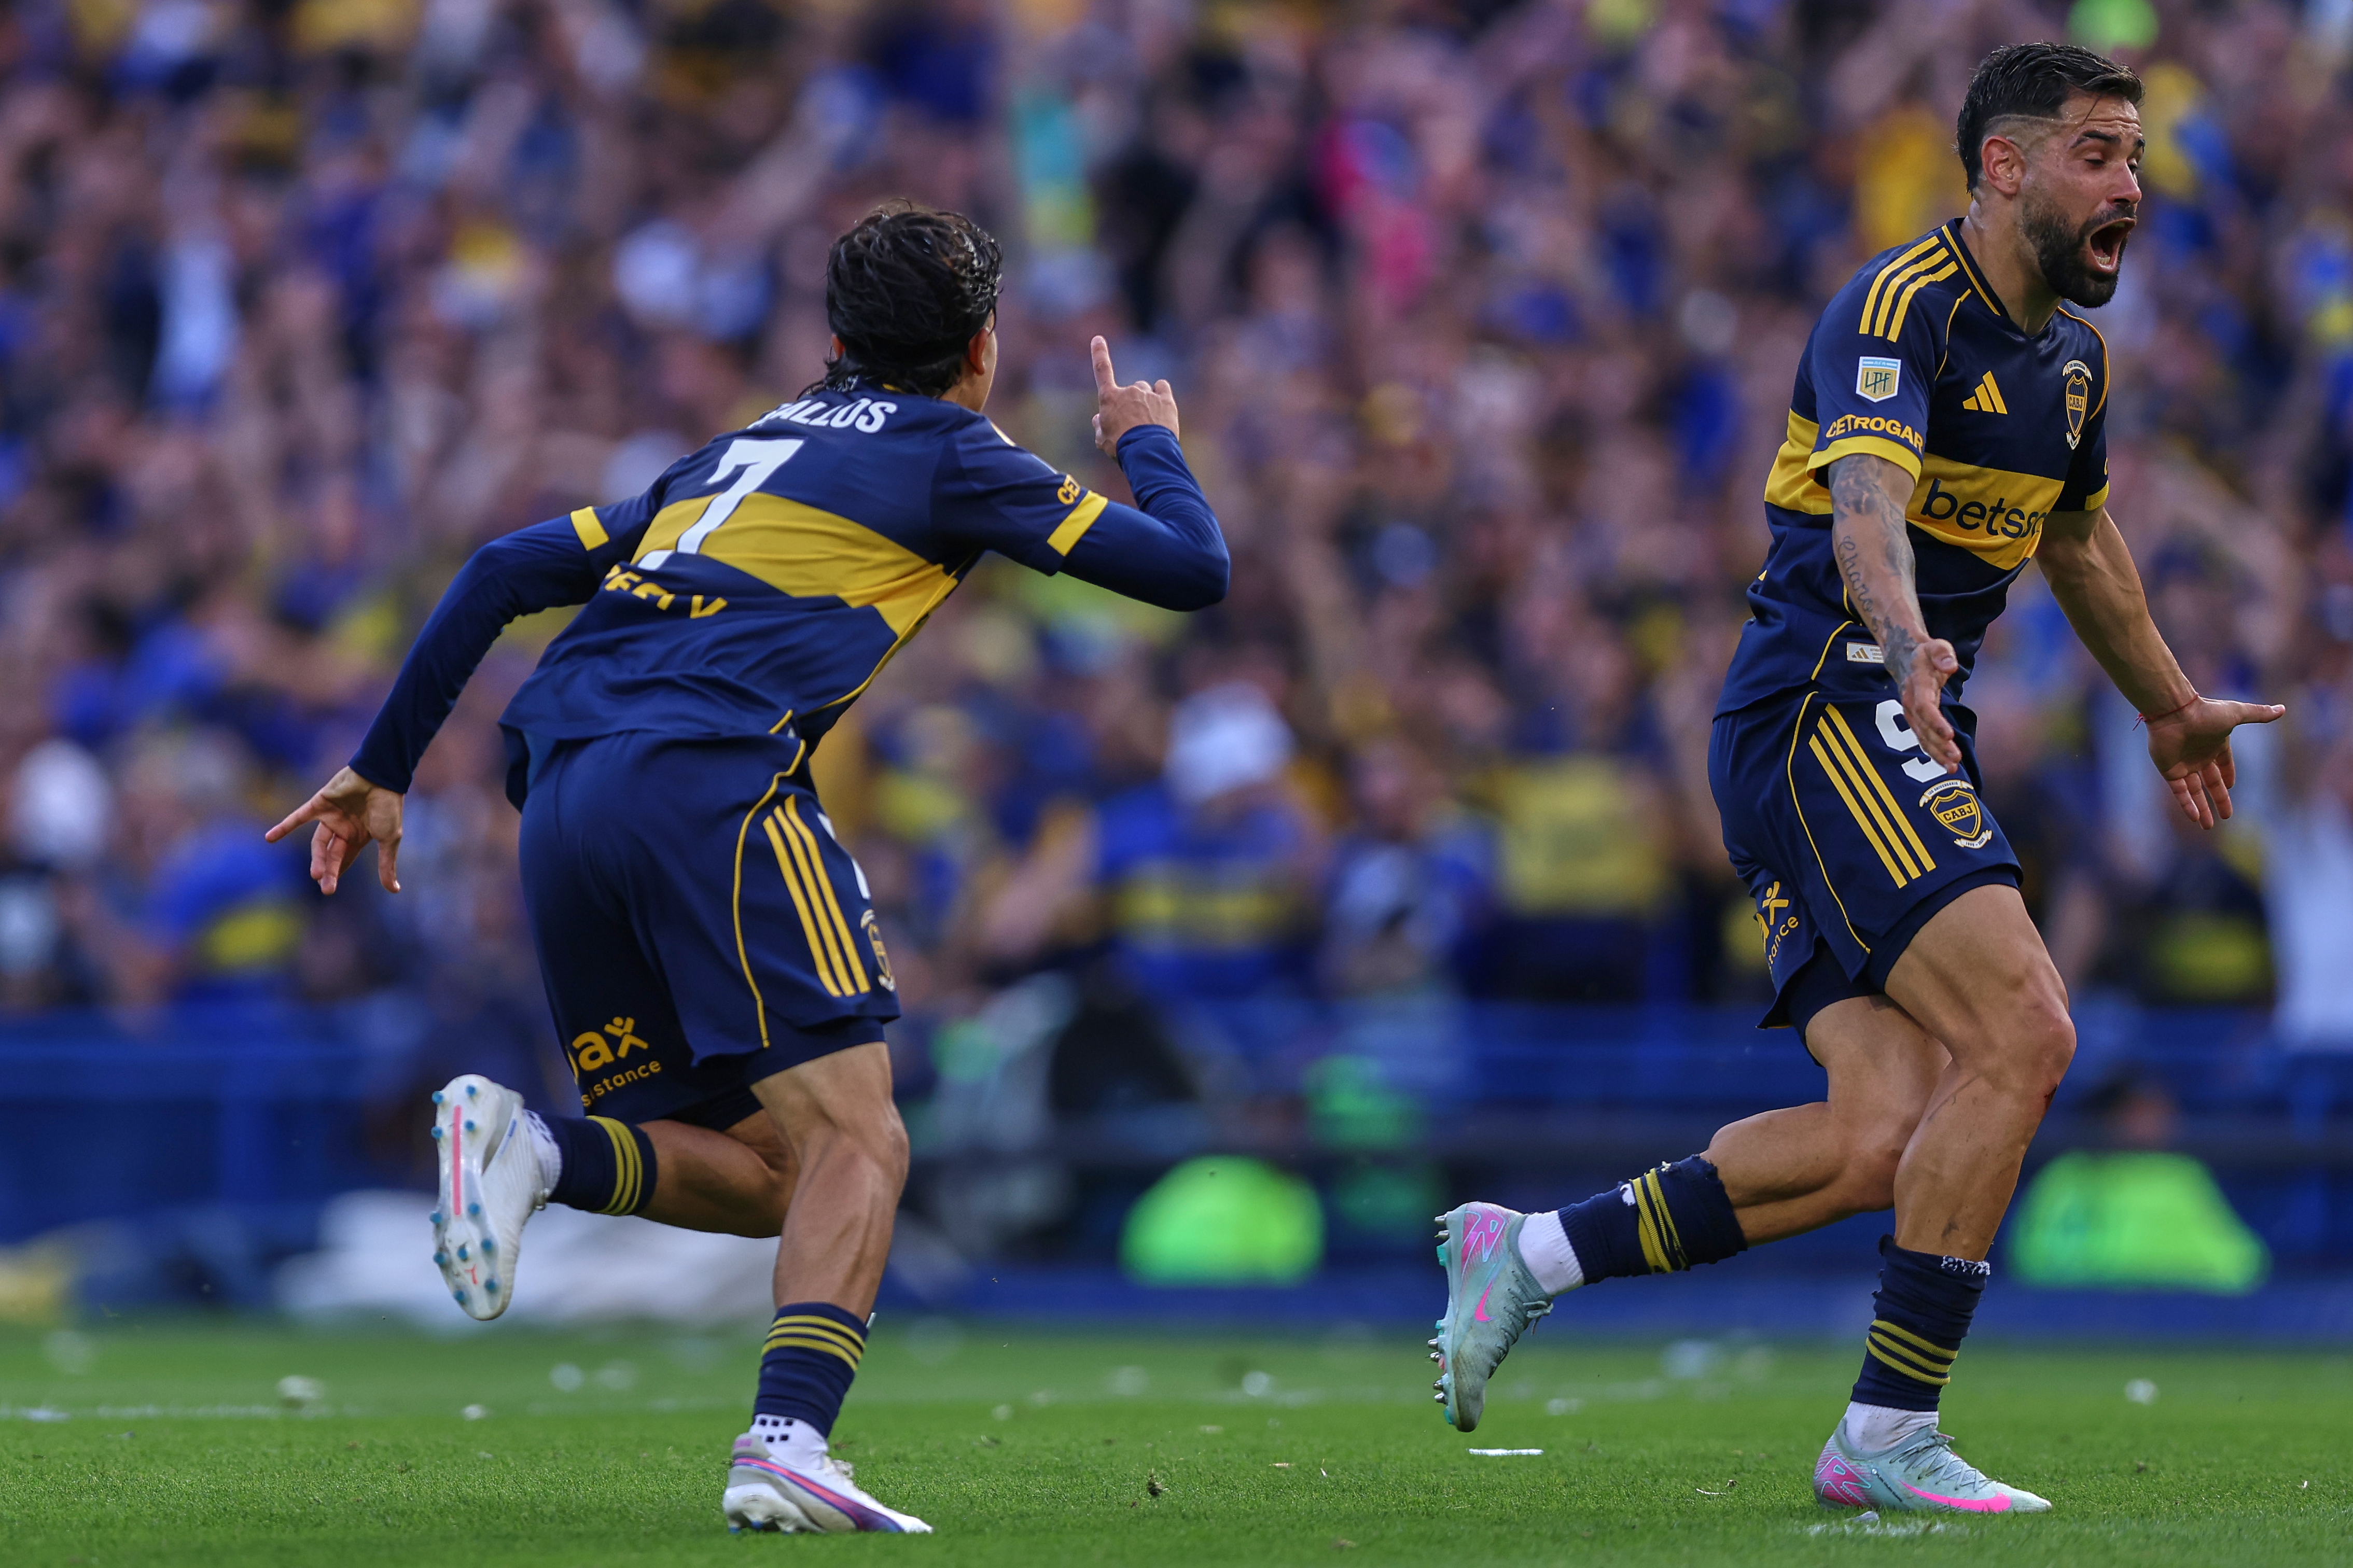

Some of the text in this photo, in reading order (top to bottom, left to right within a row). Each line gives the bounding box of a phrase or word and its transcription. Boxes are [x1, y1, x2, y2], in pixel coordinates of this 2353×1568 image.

[2068, 396, 2084, 410] CABJ
[1825, 414, 1925, 455] CETROGAR
[638, 438, 806, 571] 7
[1943, 805, 1973, 821] CABJ
